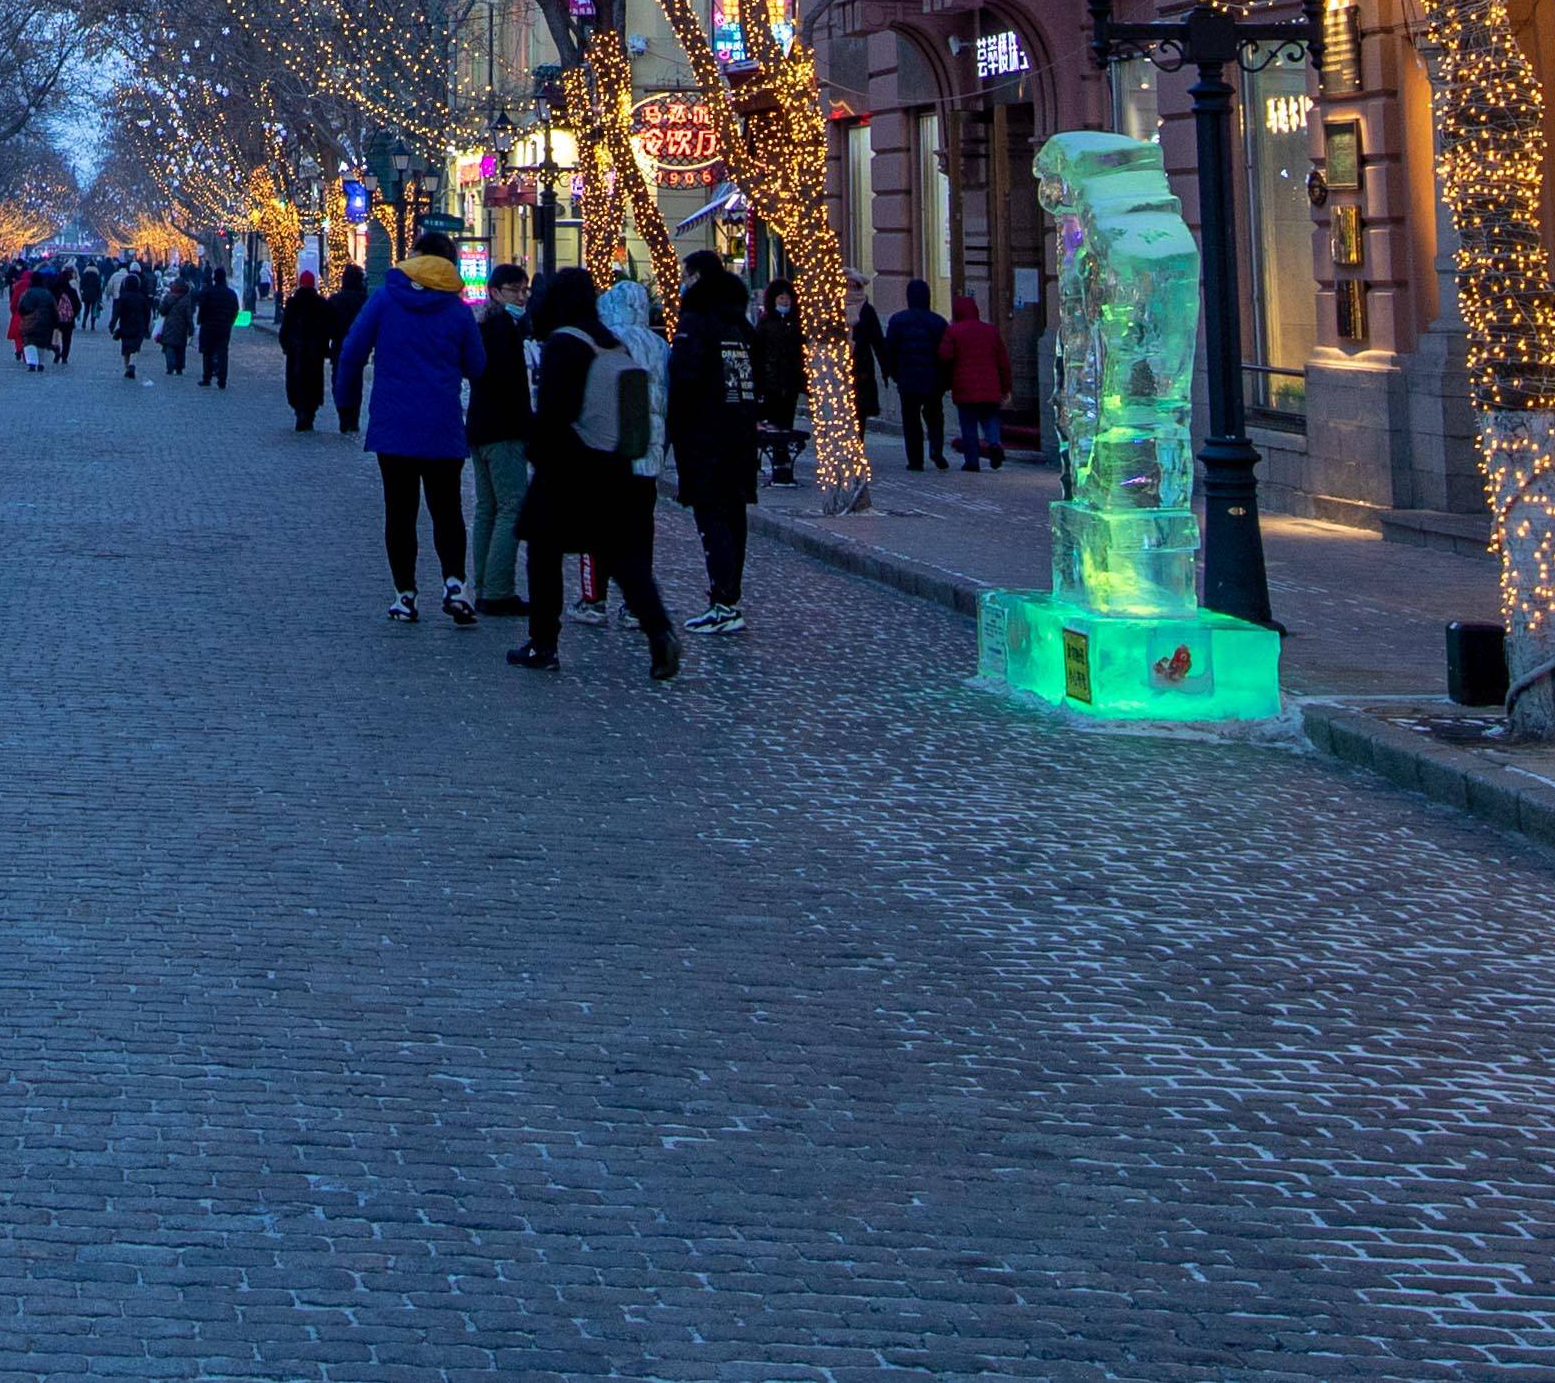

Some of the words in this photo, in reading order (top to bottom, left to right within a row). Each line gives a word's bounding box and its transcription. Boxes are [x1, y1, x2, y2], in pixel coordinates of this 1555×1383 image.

[640, 128, 717, 157] 冷饮厅
[655, 169, 712, 186] 1906
